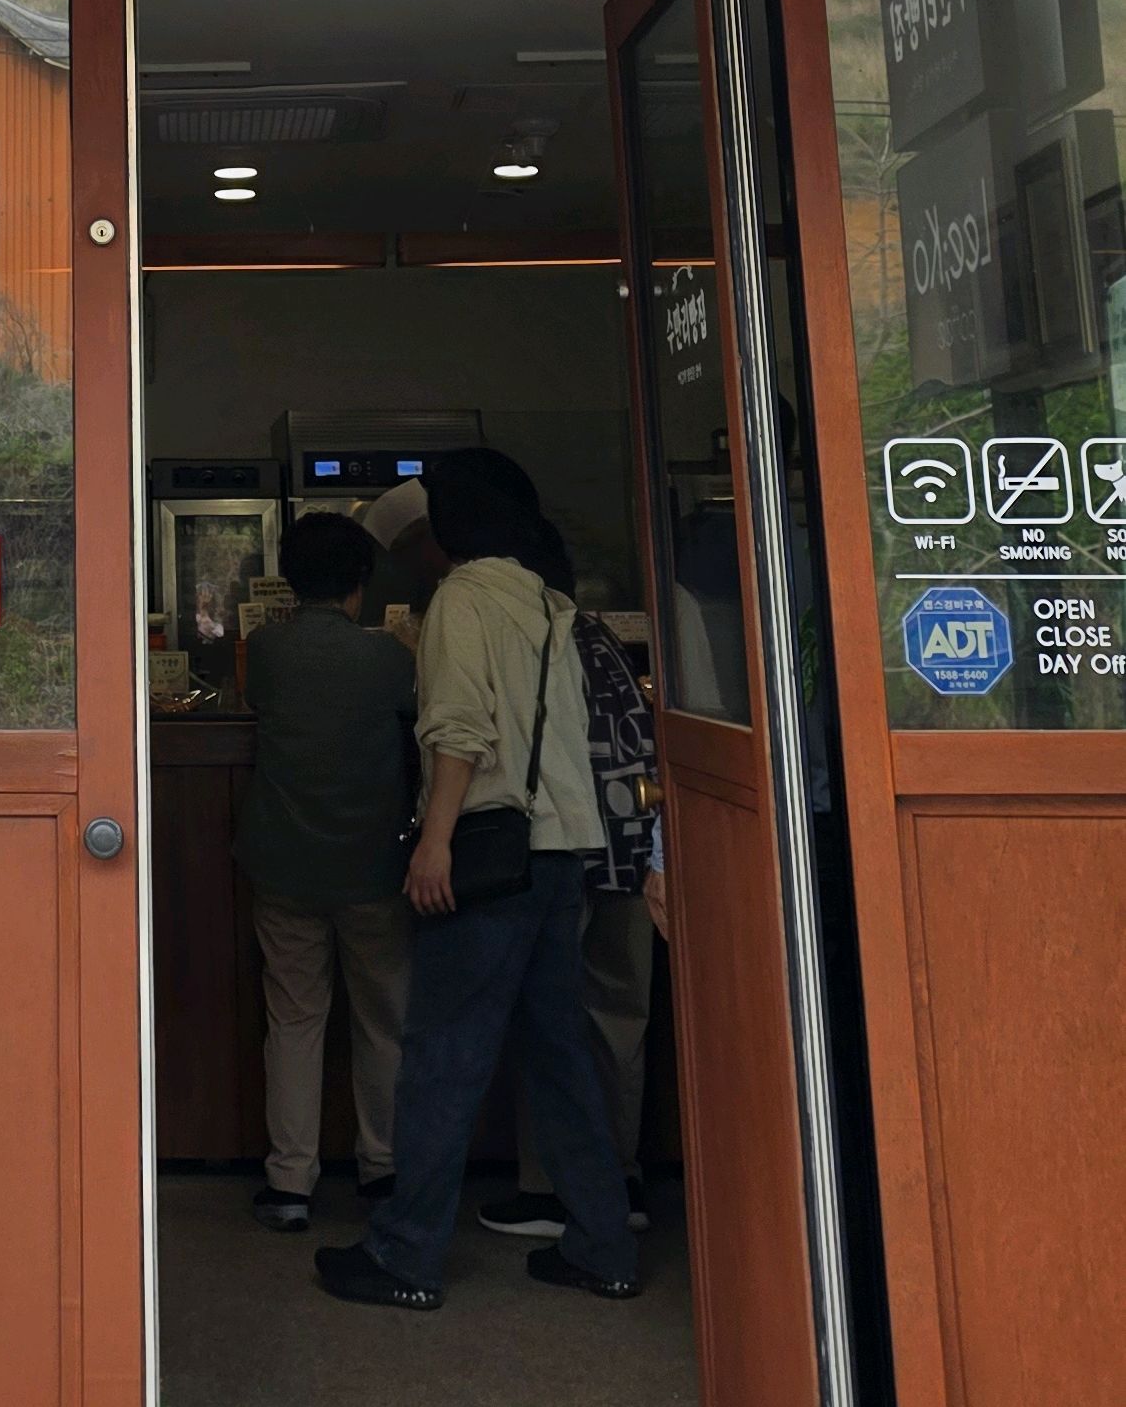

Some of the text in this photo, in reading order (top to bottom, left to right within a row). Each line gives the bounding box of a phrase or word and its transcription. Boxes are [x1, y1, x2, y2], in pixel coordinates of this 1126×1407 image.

[914, 535, 956, 550] Wi-Fi
[1022, 528, 1045, 543] NO
[1000, 546, 1072, 561] SMOKING
[1033, 599, 1095, 620] OPEN
[922, 621, 994, 659] ADT
[1036, 626, 1111, 647] CLOSE
[1038, 653, 1082, 675] DAY
